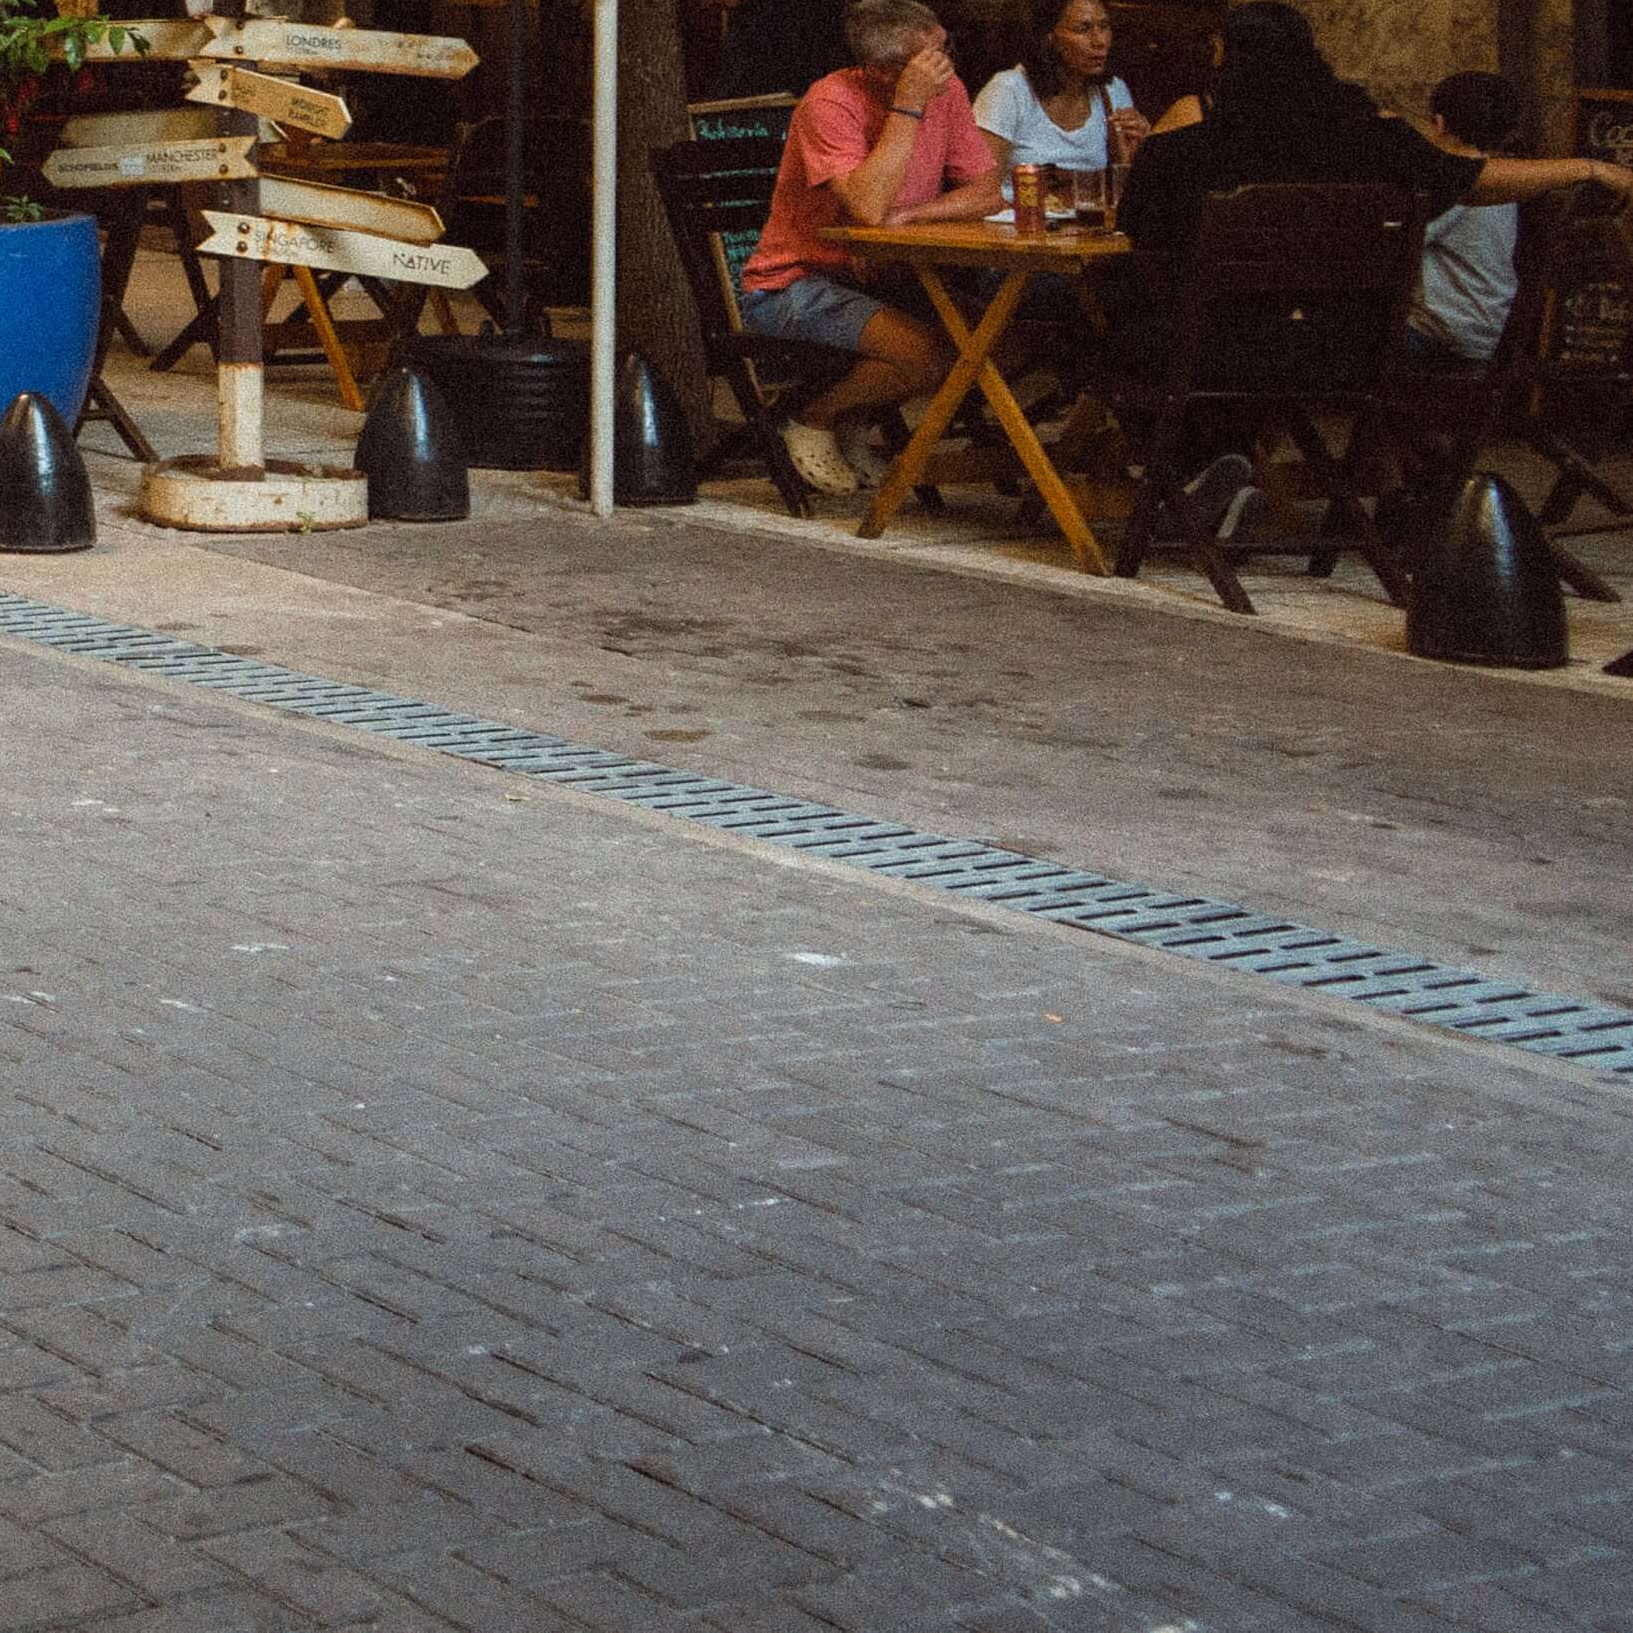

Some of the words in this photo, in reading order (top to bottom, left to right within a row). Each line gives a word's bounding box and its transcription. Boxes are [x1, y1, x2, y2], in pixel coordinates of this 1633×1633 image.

[285, 34, 342, 50] LONDRES
[146, 148, 219, 164] MANCHESTER
[255, 231, 335, 254] SINGAPORE
[393, 251, 452, 274] NATIVE
